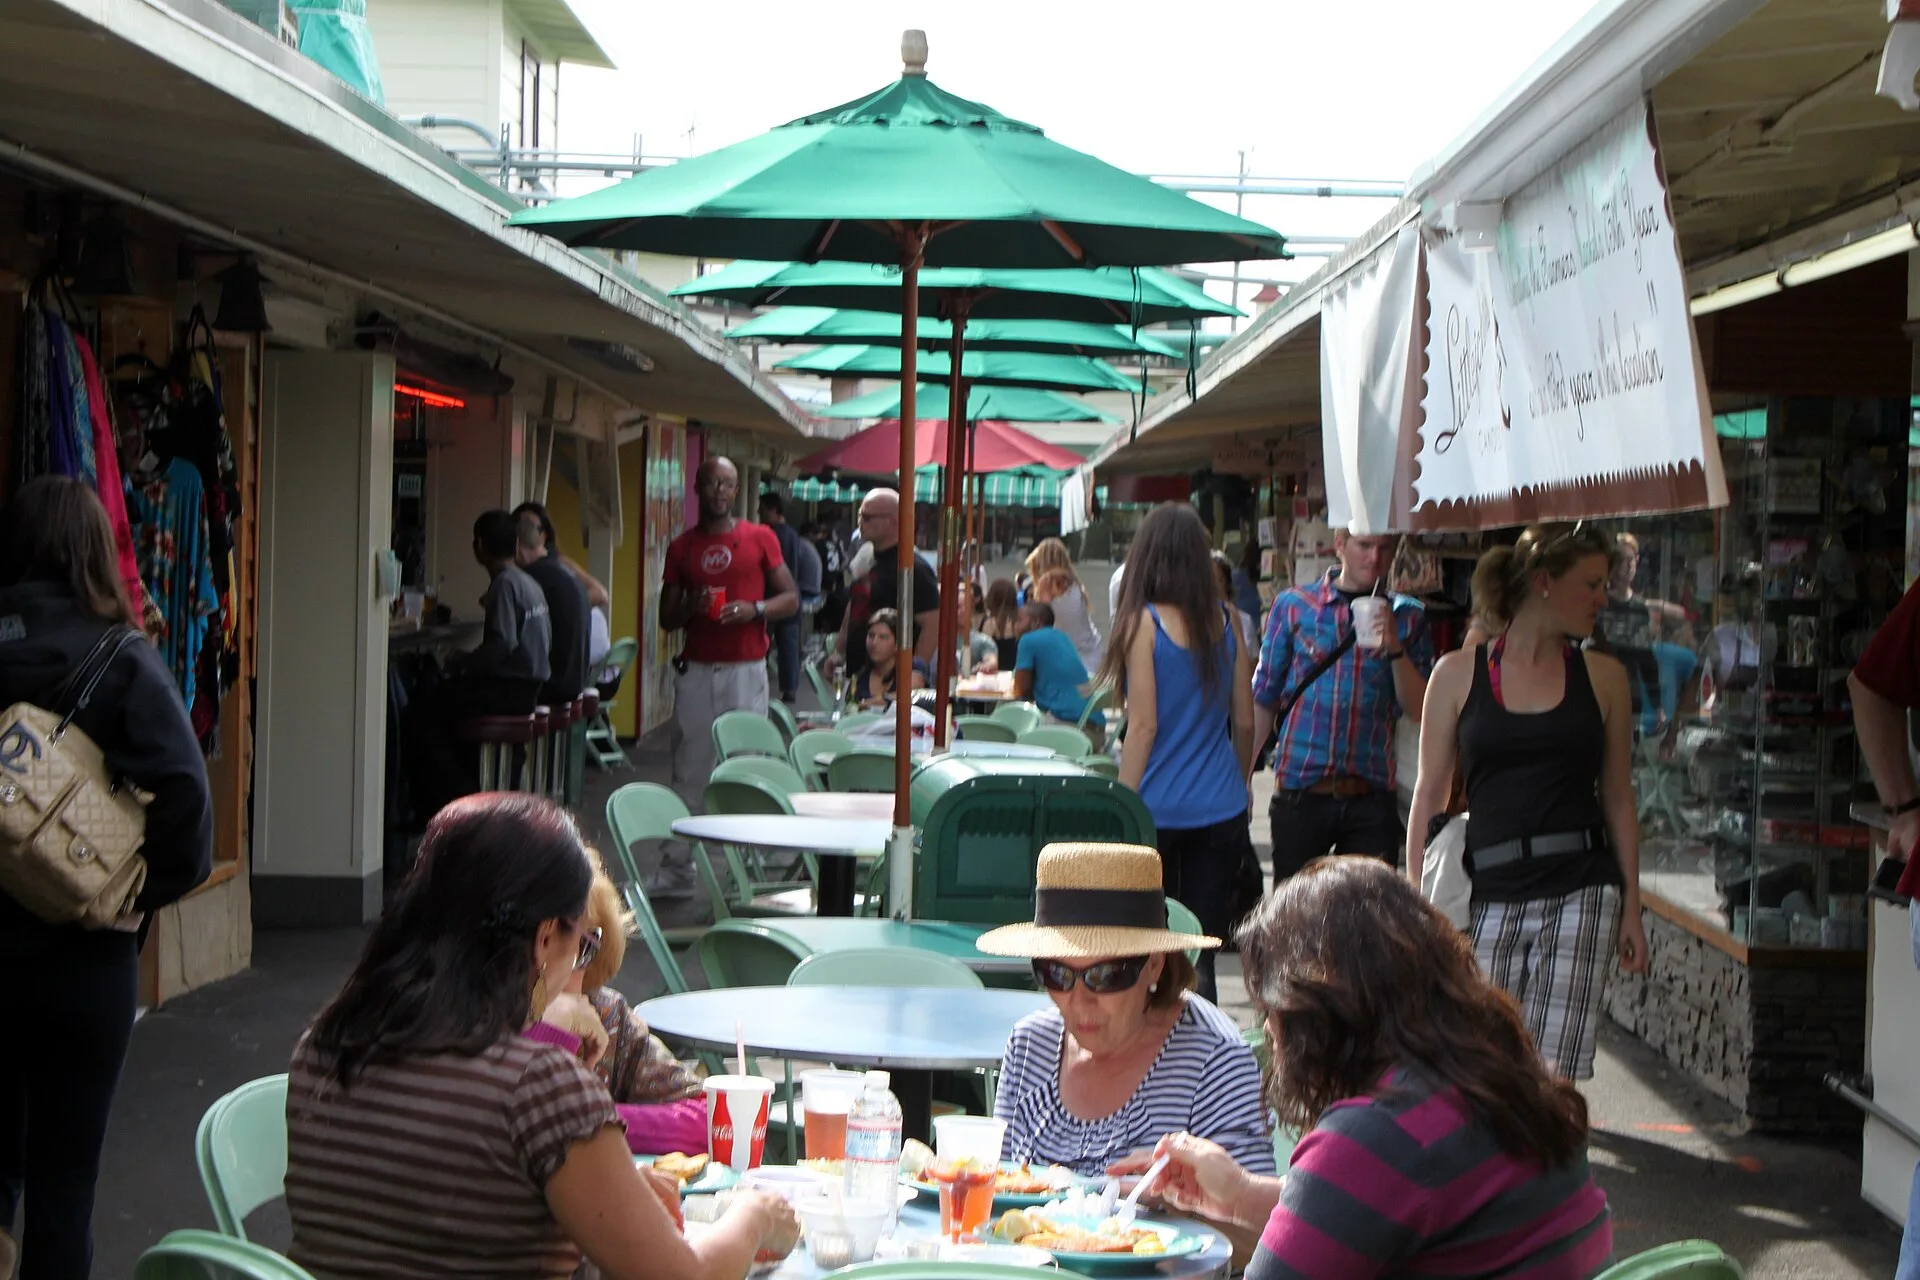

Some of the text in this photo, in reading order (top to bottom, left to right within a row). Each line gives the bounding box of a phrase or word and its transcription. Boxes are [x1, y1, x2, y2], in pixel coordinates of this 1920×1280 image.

[1621, 168, 1659, 274] Year
[1570, 370, 1597, 442] year
[1613, 311, 1664, 392] location
